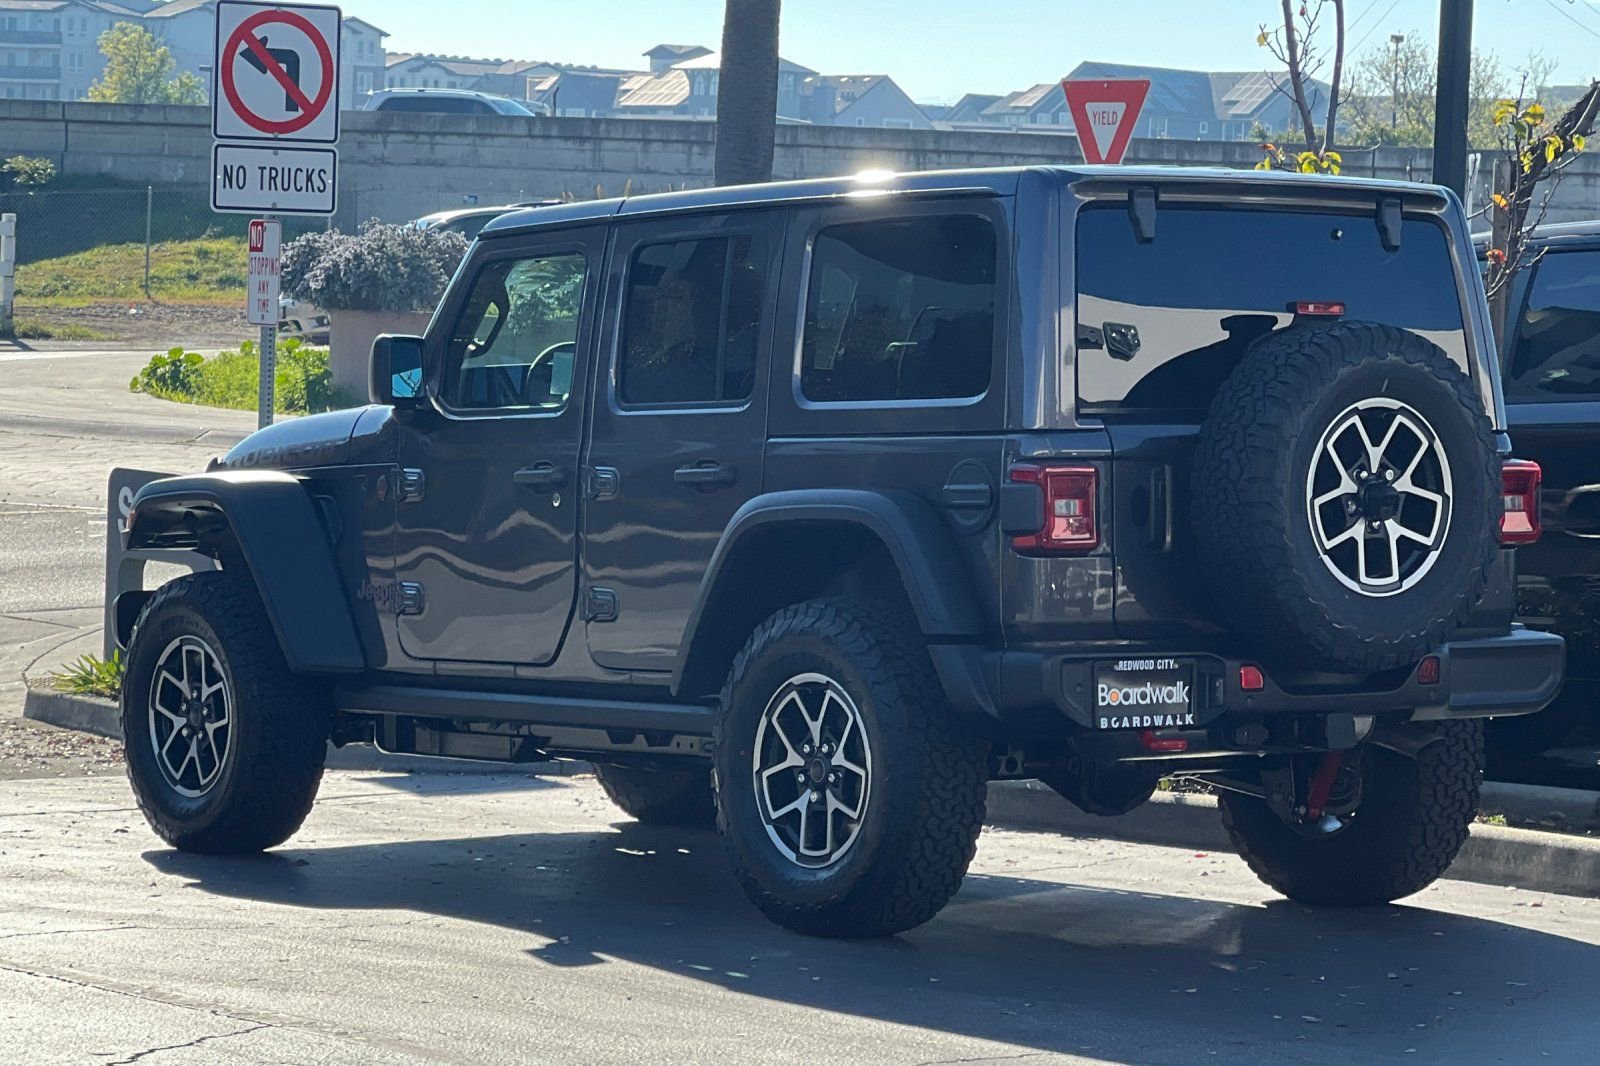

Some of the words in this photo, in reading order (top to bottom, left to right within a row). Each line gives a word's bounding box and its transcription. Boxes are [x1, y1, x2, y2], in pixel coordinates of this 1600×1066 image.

[1092, 111, 1118, 126] YIELD
[222, 164, 247, 190] NO
[258, 166, 327, 193] TRUCKS
[250, 225, 263, 248] NO
[249, 256, 279, 276] STOPPING
[257, 280, 270, 294] ANY
[257, 298, 270, 313] TIME
[1118, 659, 1155, 671] REDWOOD
[1157, 658, 1175, 670] CITY
[1097, 680, 1190, 706] Boardwalk
[1100, 713, 1195, 729] BOARDWALK
